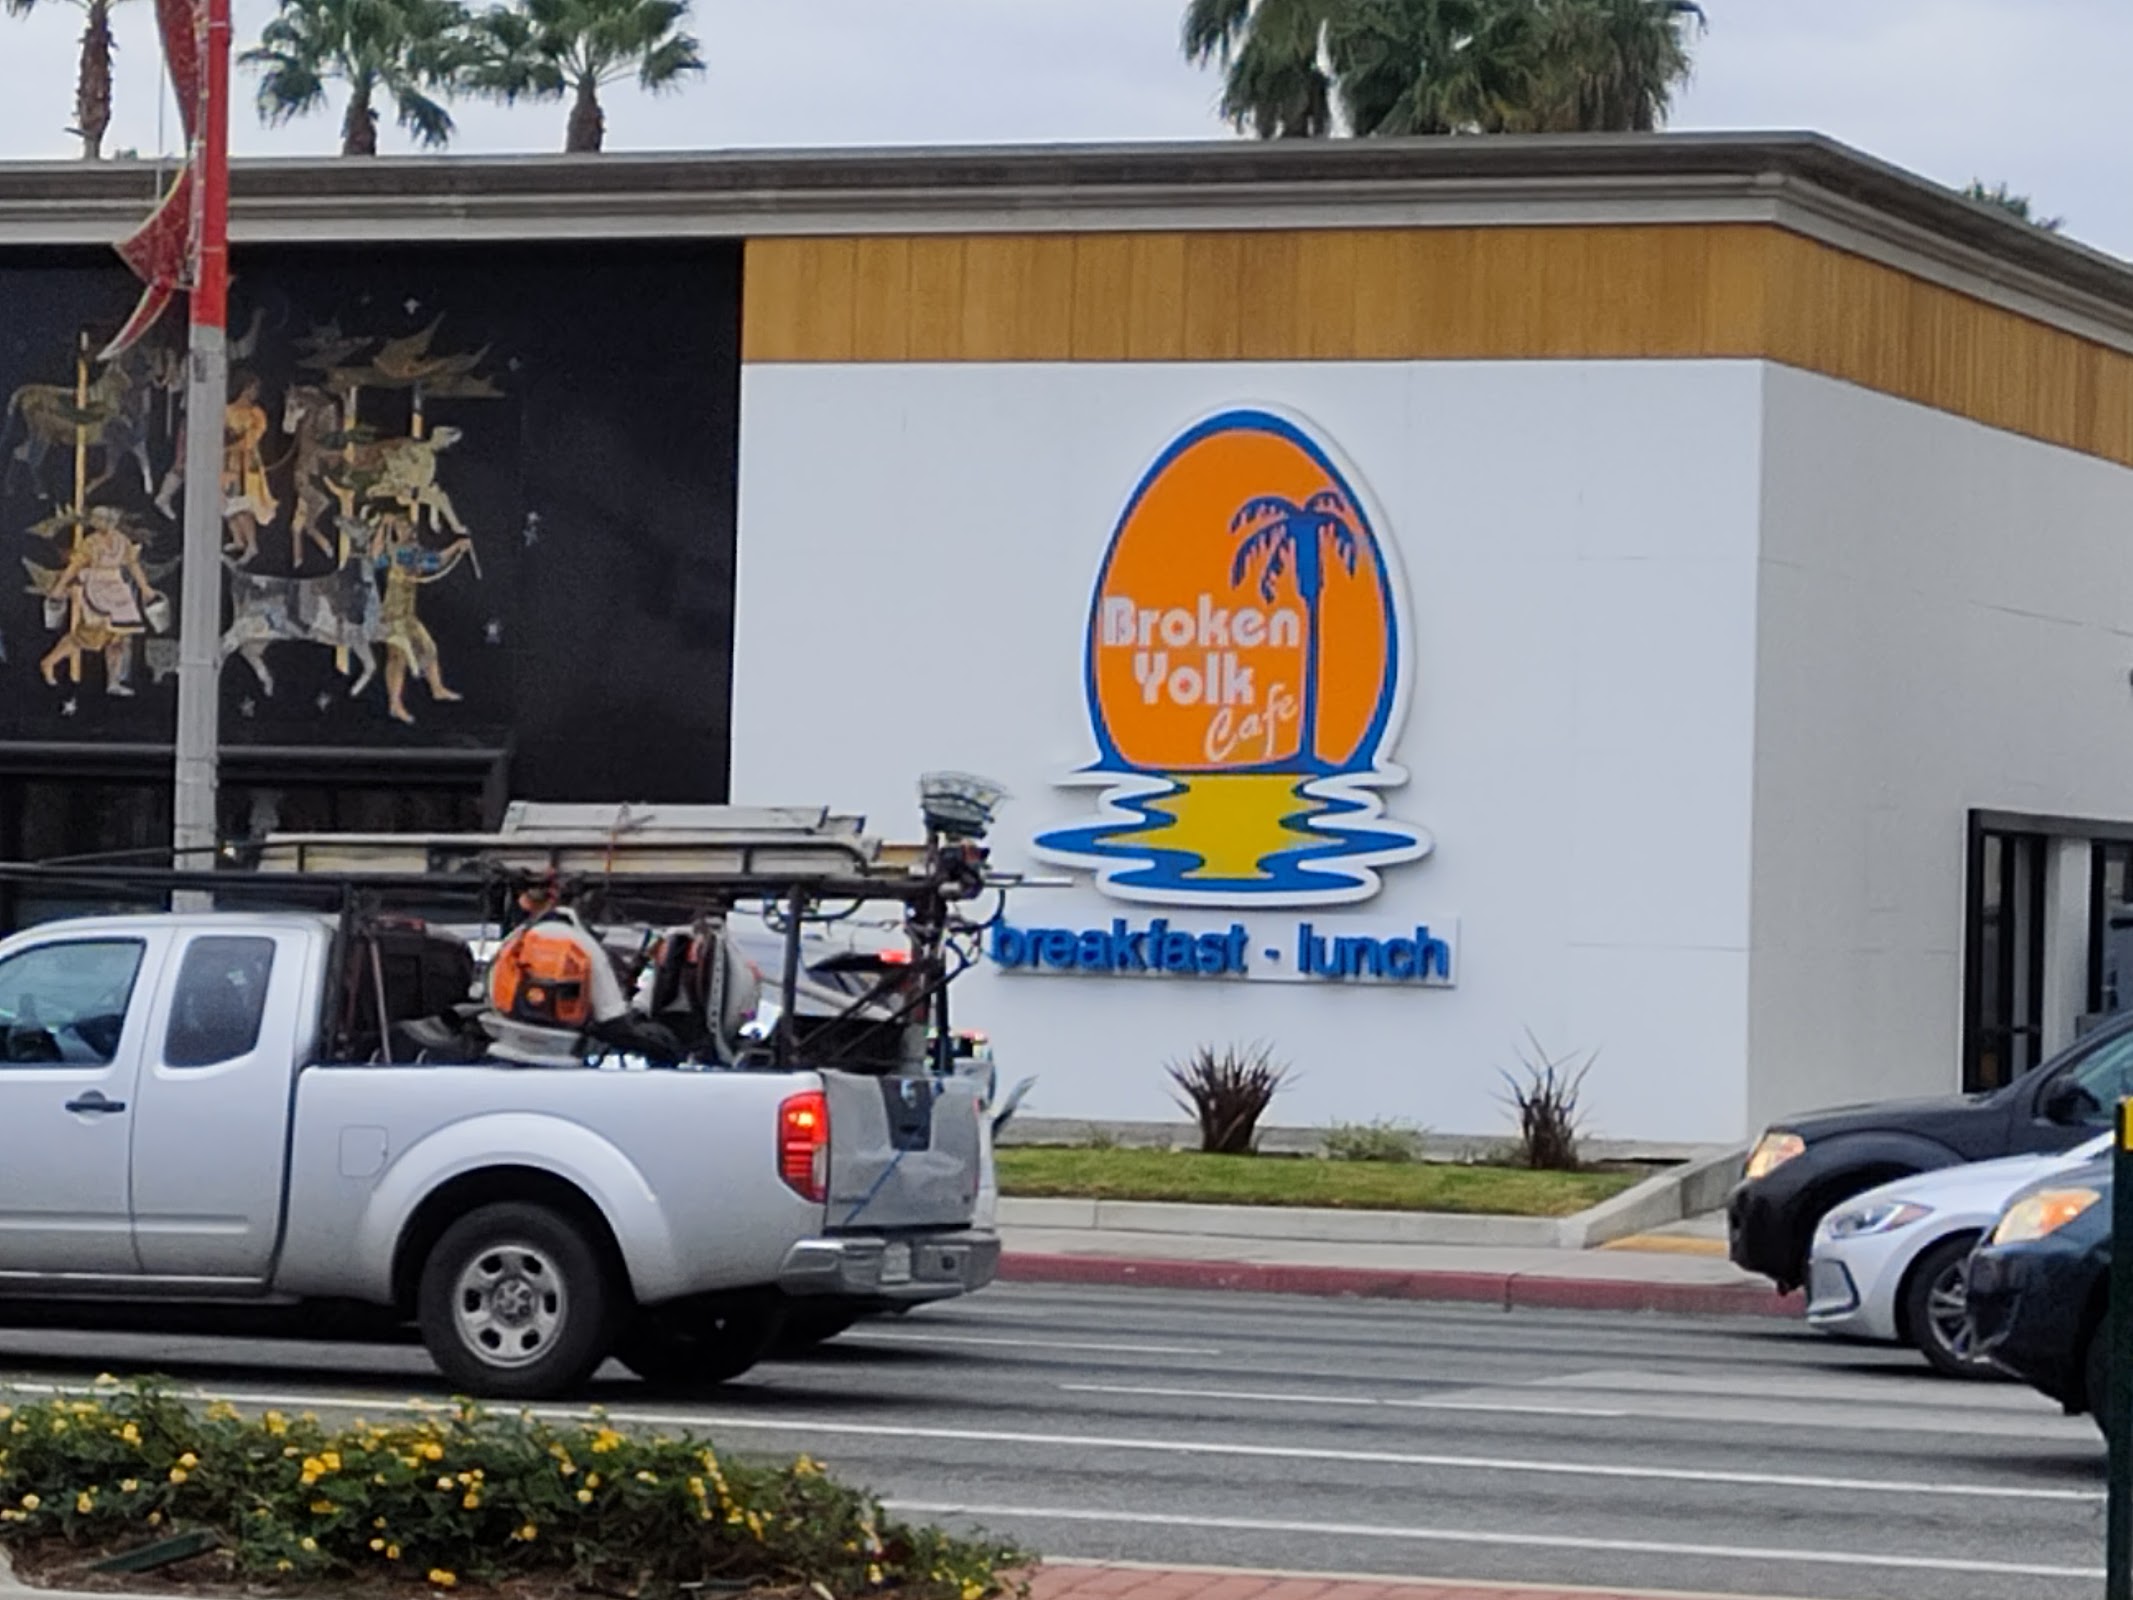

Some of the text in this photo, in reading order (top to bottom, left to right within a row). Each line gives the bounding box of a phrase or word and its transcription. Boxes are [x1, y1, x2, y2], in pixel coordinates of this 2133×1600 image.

[1102, 594, 1300, 647] Broken
[1134, 652, 1255, 705] Yolk
[1205, 683, 1296, 762] Cafe
[991, 918, 1249, 974] breakfast
[1298, 923, 1449, 979] lunch
